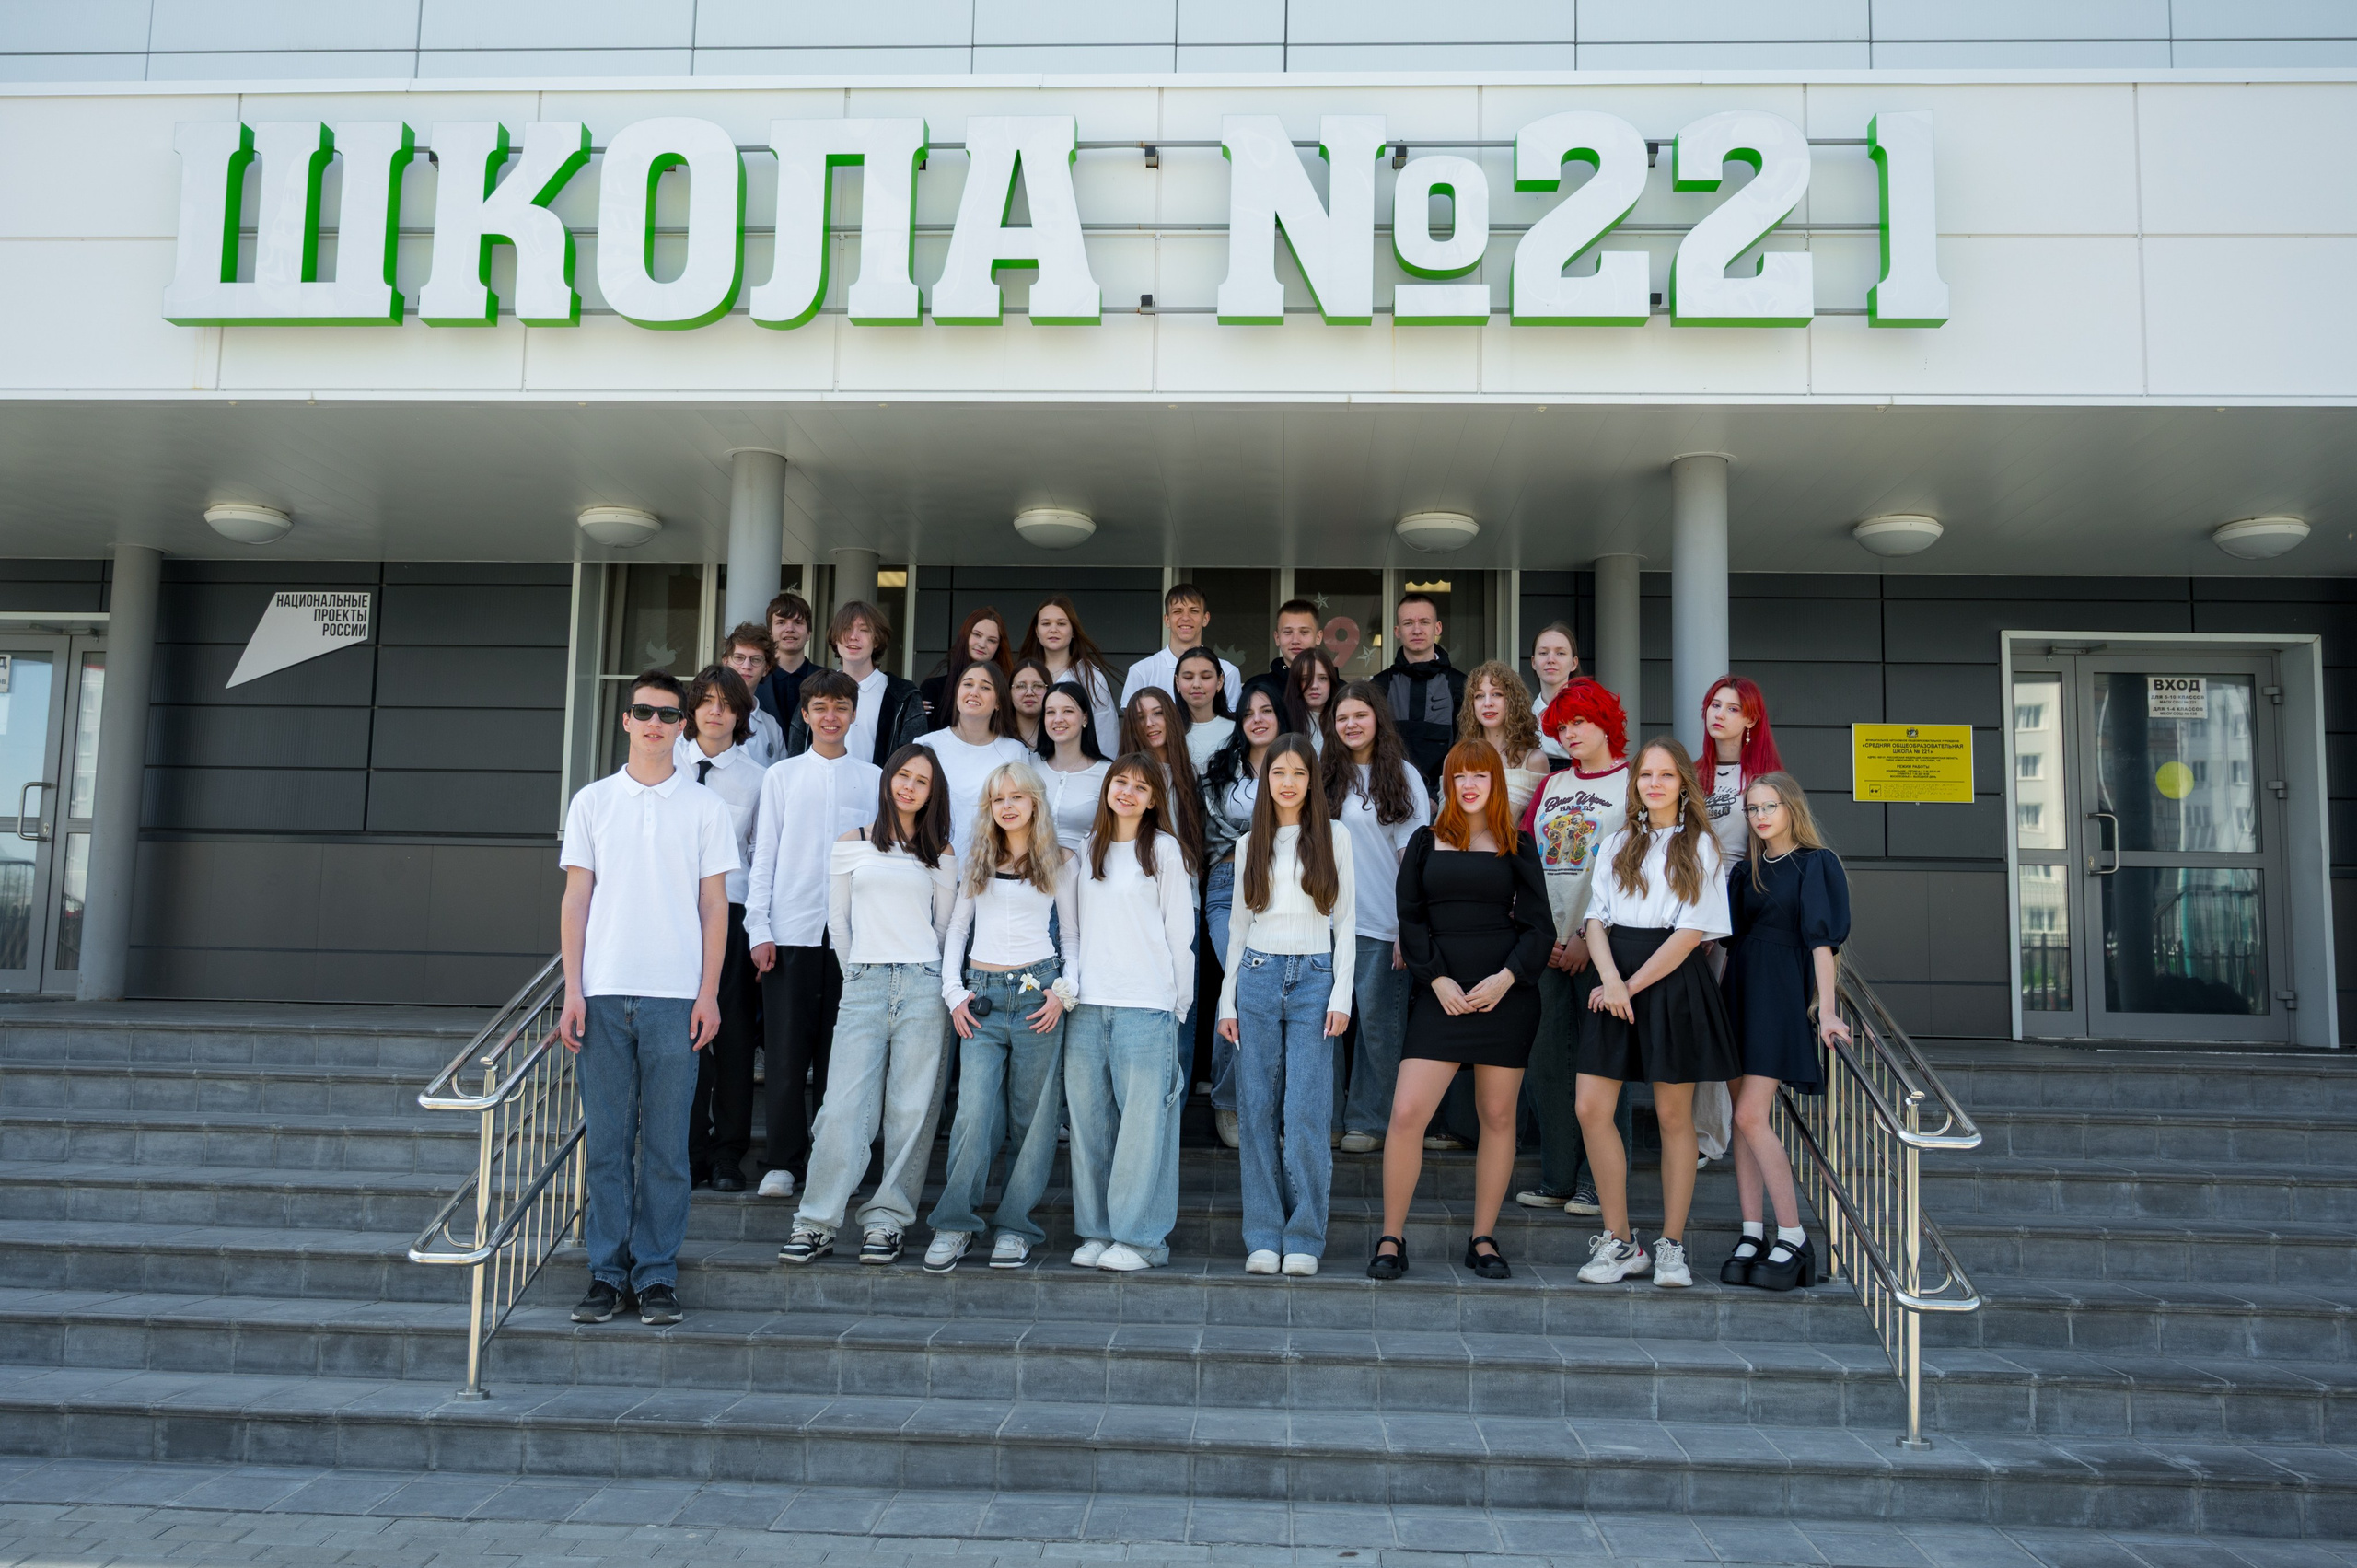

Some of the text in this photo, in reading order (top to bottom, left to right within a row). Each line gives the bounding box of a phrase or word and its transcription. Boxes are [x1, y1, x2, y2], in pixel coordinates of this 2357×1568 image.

[162, 116, 1103, 331] ШКОЛА
[276, 594, 368, 609] НАЦИОНАЛЬНЫЕ
[314, 609, 367, 622] ПРОЕКТЫ
[322, 623, 366, 637] РОССИИ
[2154, 679, 2200, 692] ВХОД
